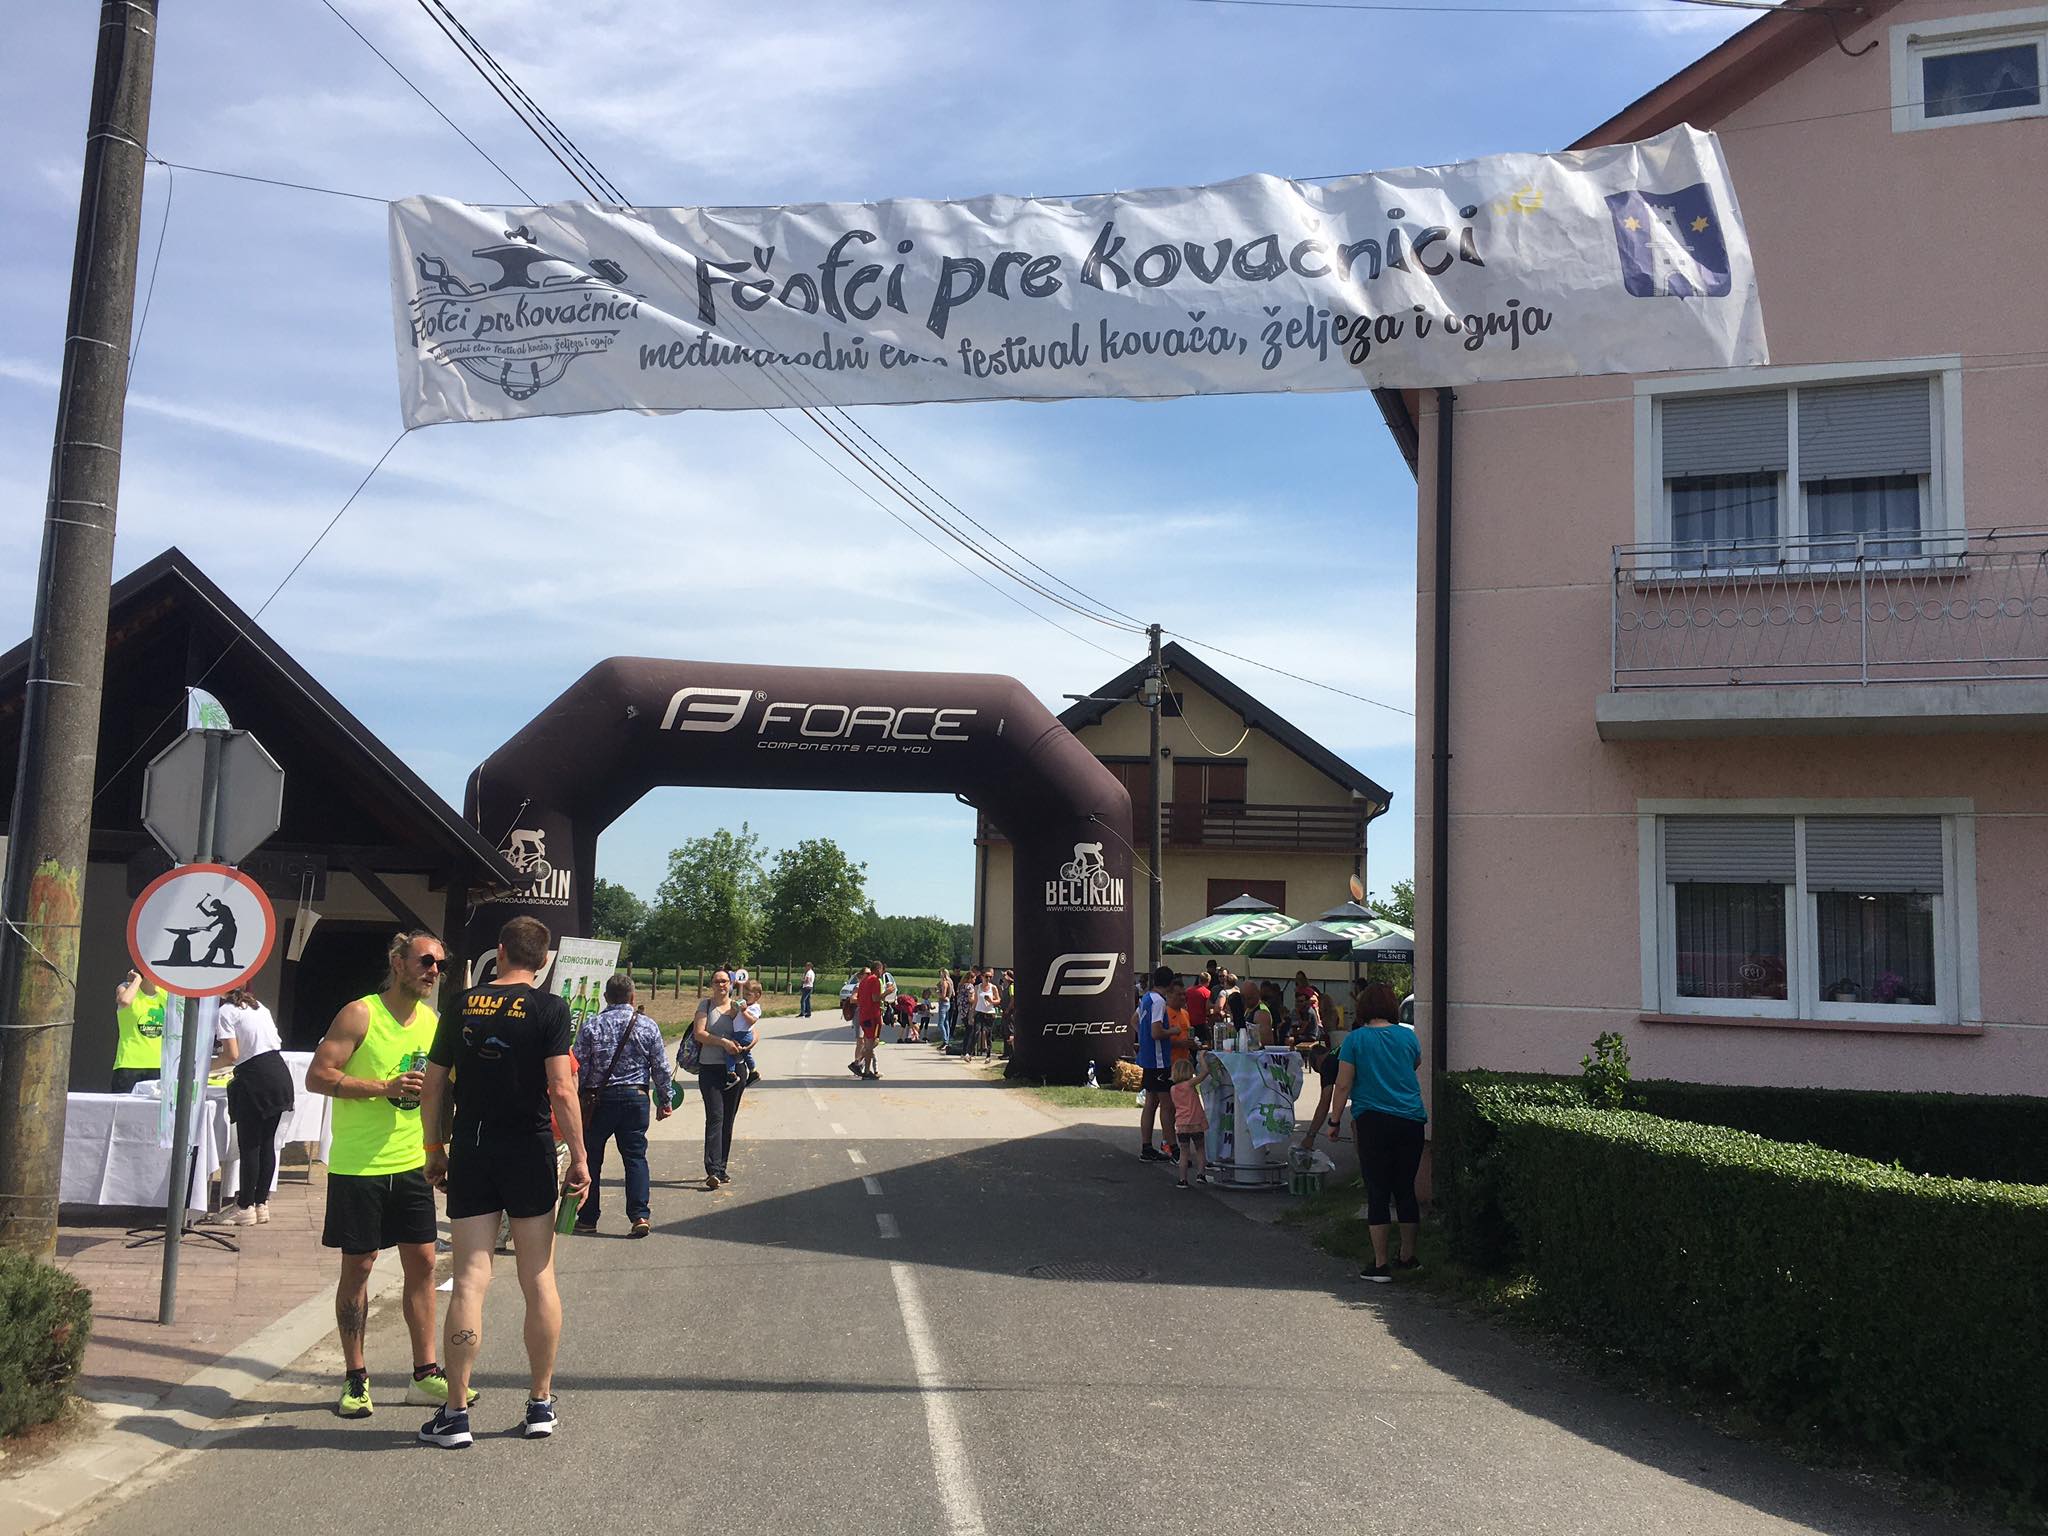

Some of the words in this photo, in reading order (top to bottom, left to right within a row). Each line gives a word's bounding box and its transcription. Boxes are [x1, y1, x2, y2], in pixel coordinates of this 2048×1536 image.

[926, 251, 1063, 340] pre
[1080, 203, 1485, 291] kovačnici
[958, 322, 1090, 378] festival
[1099, 311, 1248, 363] kovača,
[1260, 305, 1404, 371] željeza
[1413, 304, 1432, 339] i
[1443, 299, 1553, 352] ognja
[757, 702, 978, 741] FORCE
[757, 741, 861, 752] COMPONENTS
[865, 744, 898, 753] FOR
[902, 745, 932, 755] YOU
[1045, 877, 1124, 906] BECIKLIN
[1217, 915, 1283, 941] PAN
[559, 954, 604, 967] JEDNOSTAVNO
[462, 1008, 497, 1016] RUNNIN
[1042, 1021, 1128, 1036] FORCE.cz
